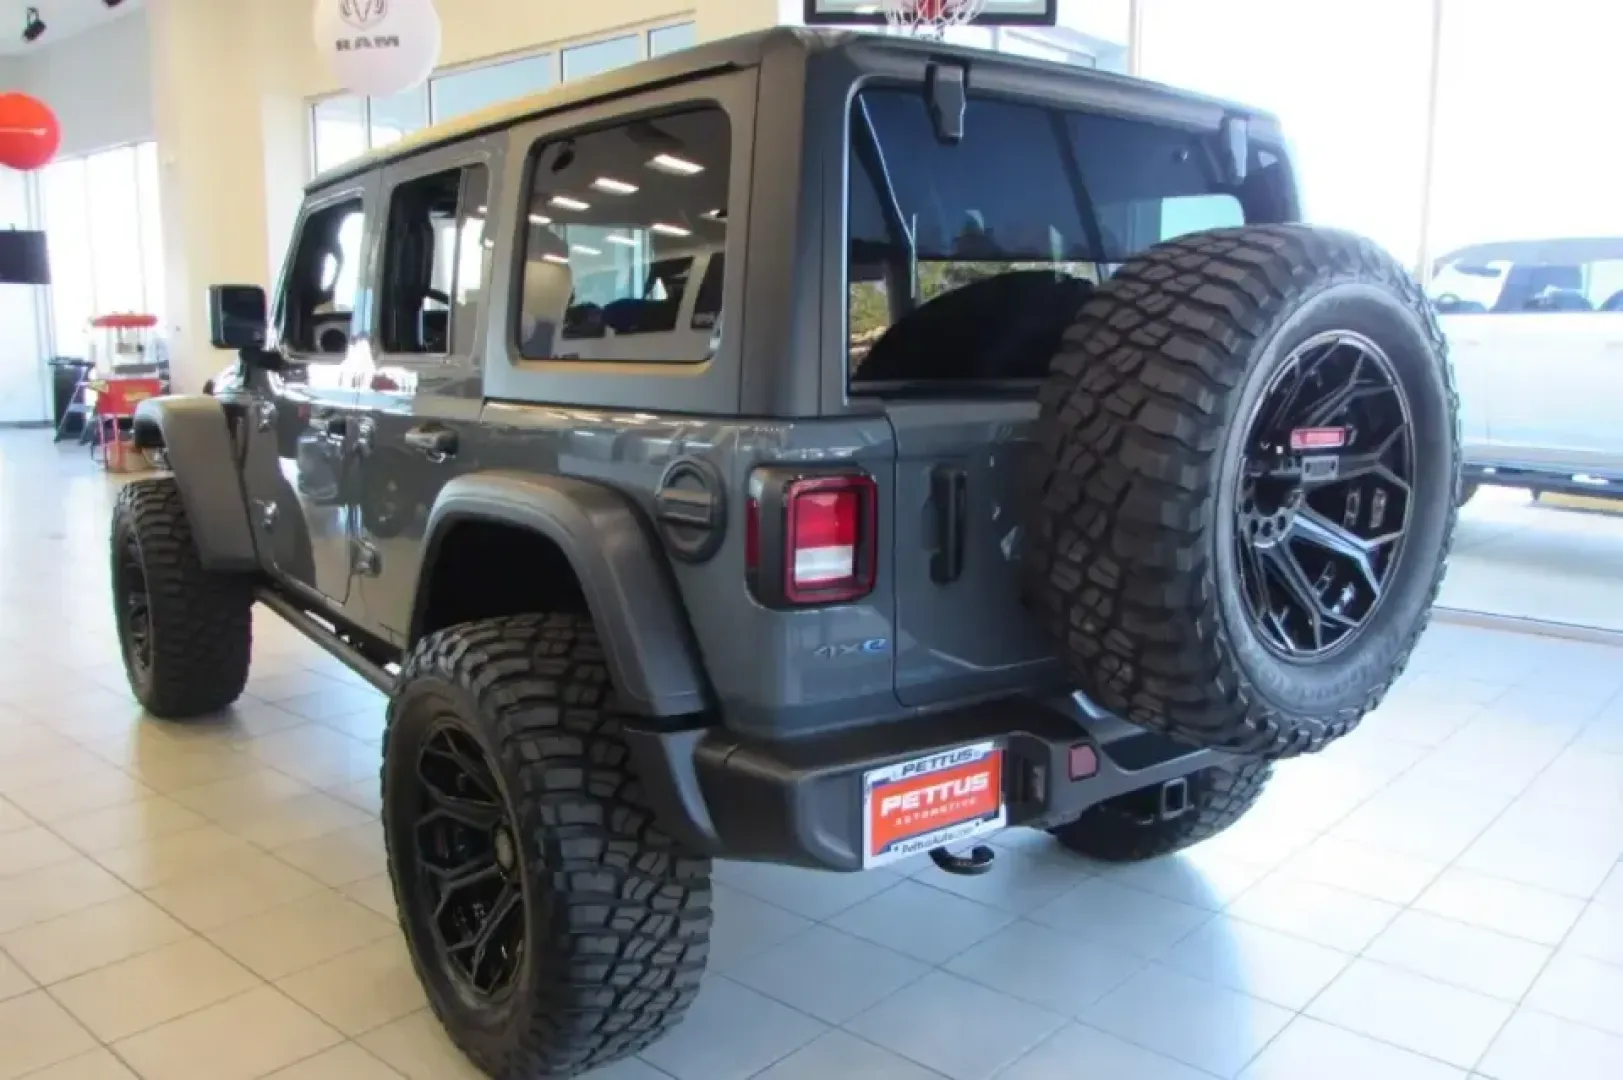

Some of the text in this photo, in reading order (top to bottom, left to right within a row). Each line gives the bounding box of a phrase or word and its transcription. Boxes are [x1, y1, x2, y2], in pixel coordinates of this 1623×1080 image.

[335, 35, 400, 52] RAM
[902, 748, 973, 775] PETTUS
[880, 771, 990, 818] PETTUS
[894, 797, 977, 827] AUTOMOTIVE
